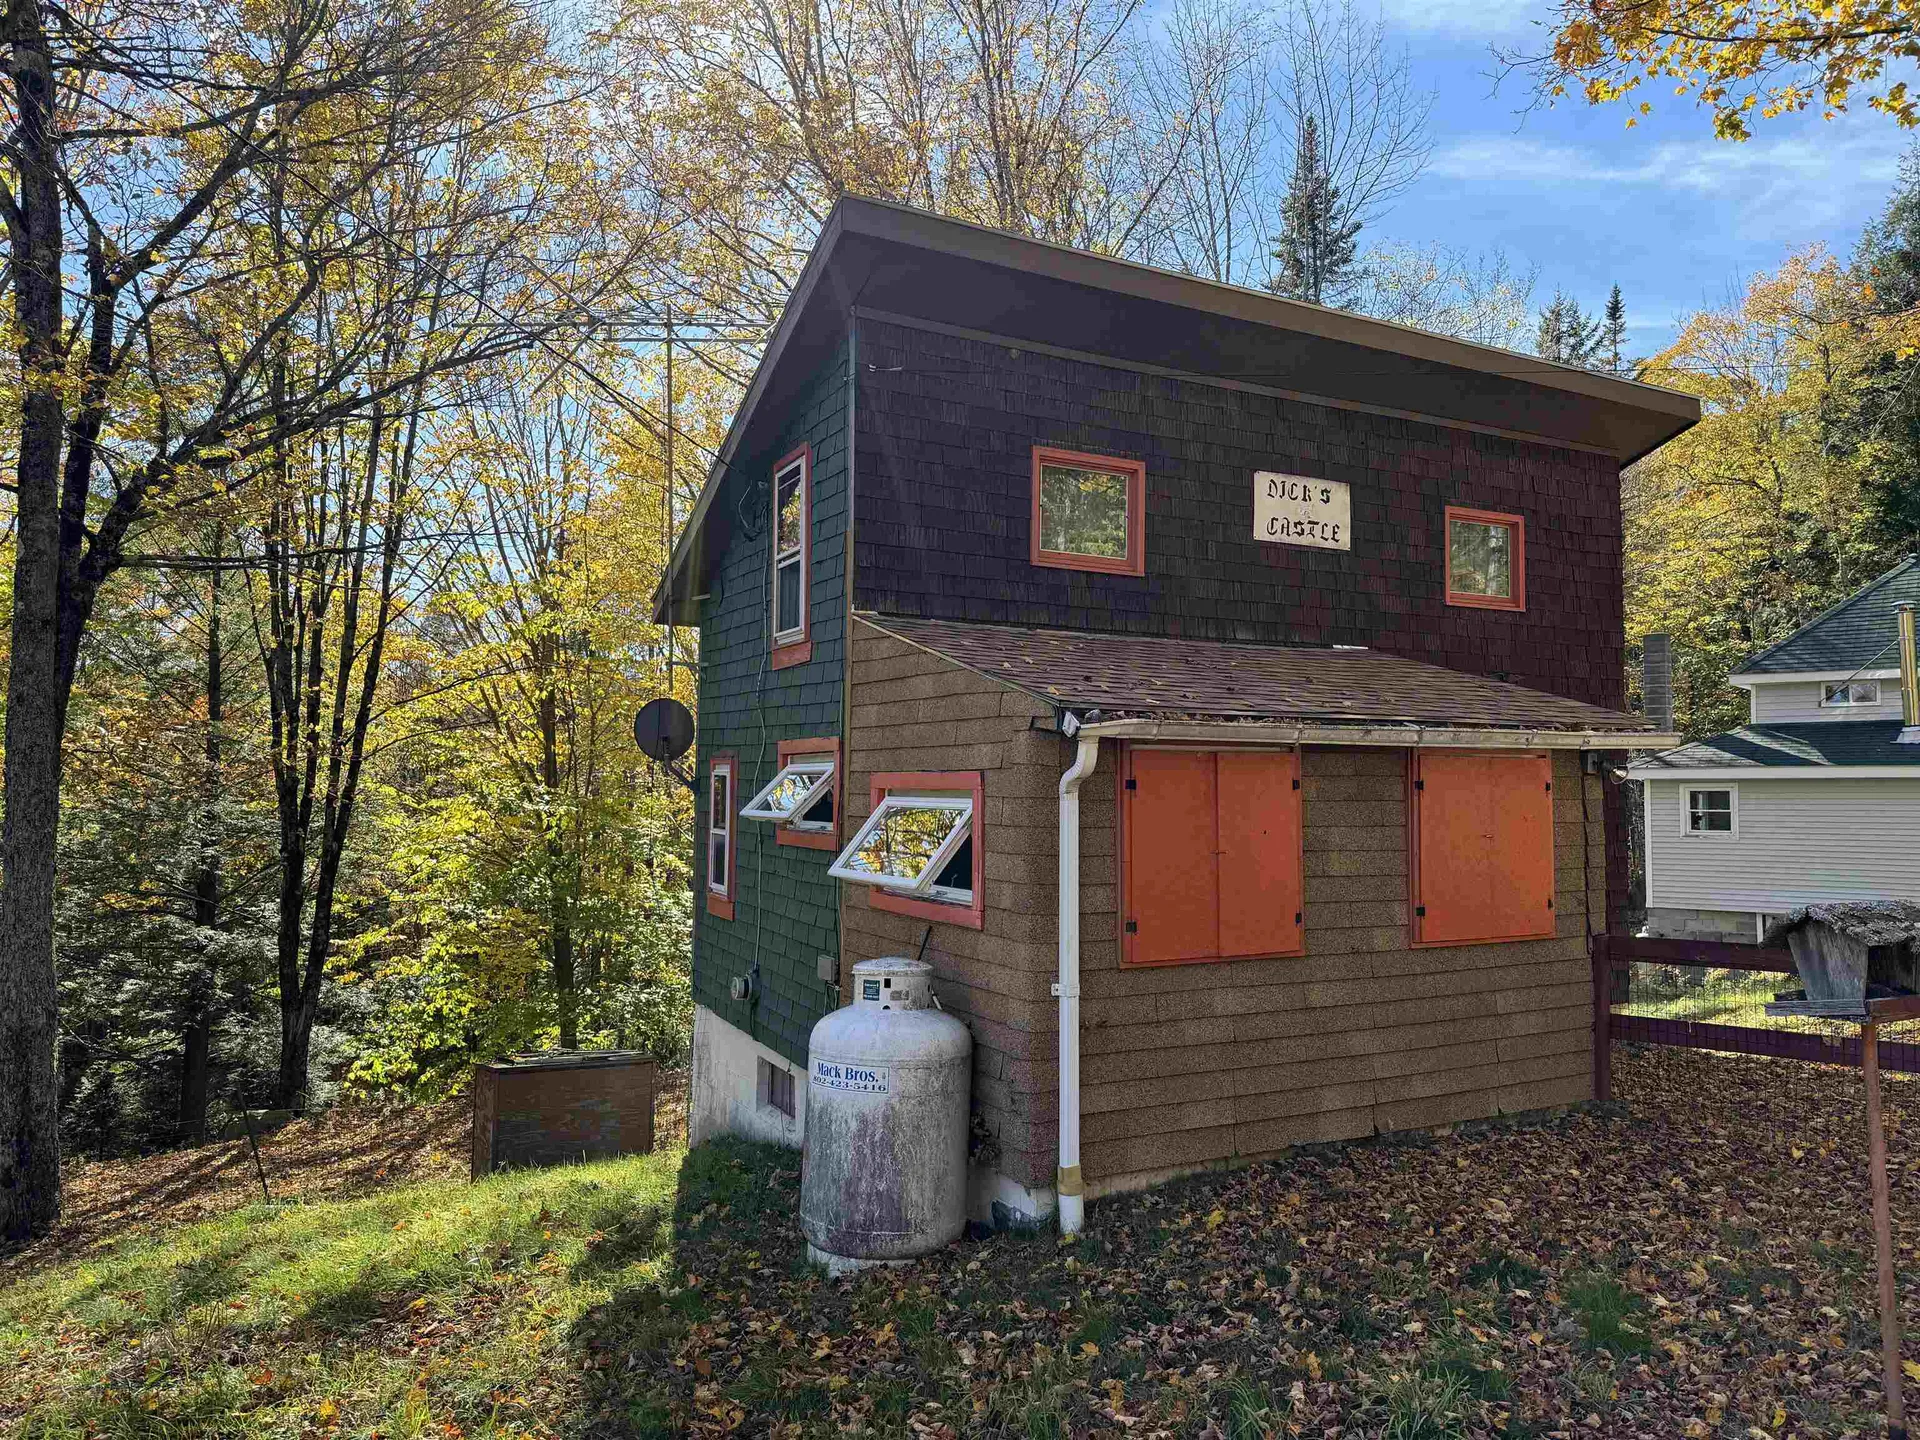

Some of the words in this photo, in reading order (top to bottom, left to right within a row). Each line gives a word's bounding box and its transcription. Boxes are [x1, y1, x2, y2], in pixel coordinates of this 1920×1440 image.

[1267, 479, 1331, 504] DICK'S
[1266, 516, 1341, 543] CASTLE
[818, 1062, 841, 1079] Mack
[845, 1067, 879, 1082] Bros.
